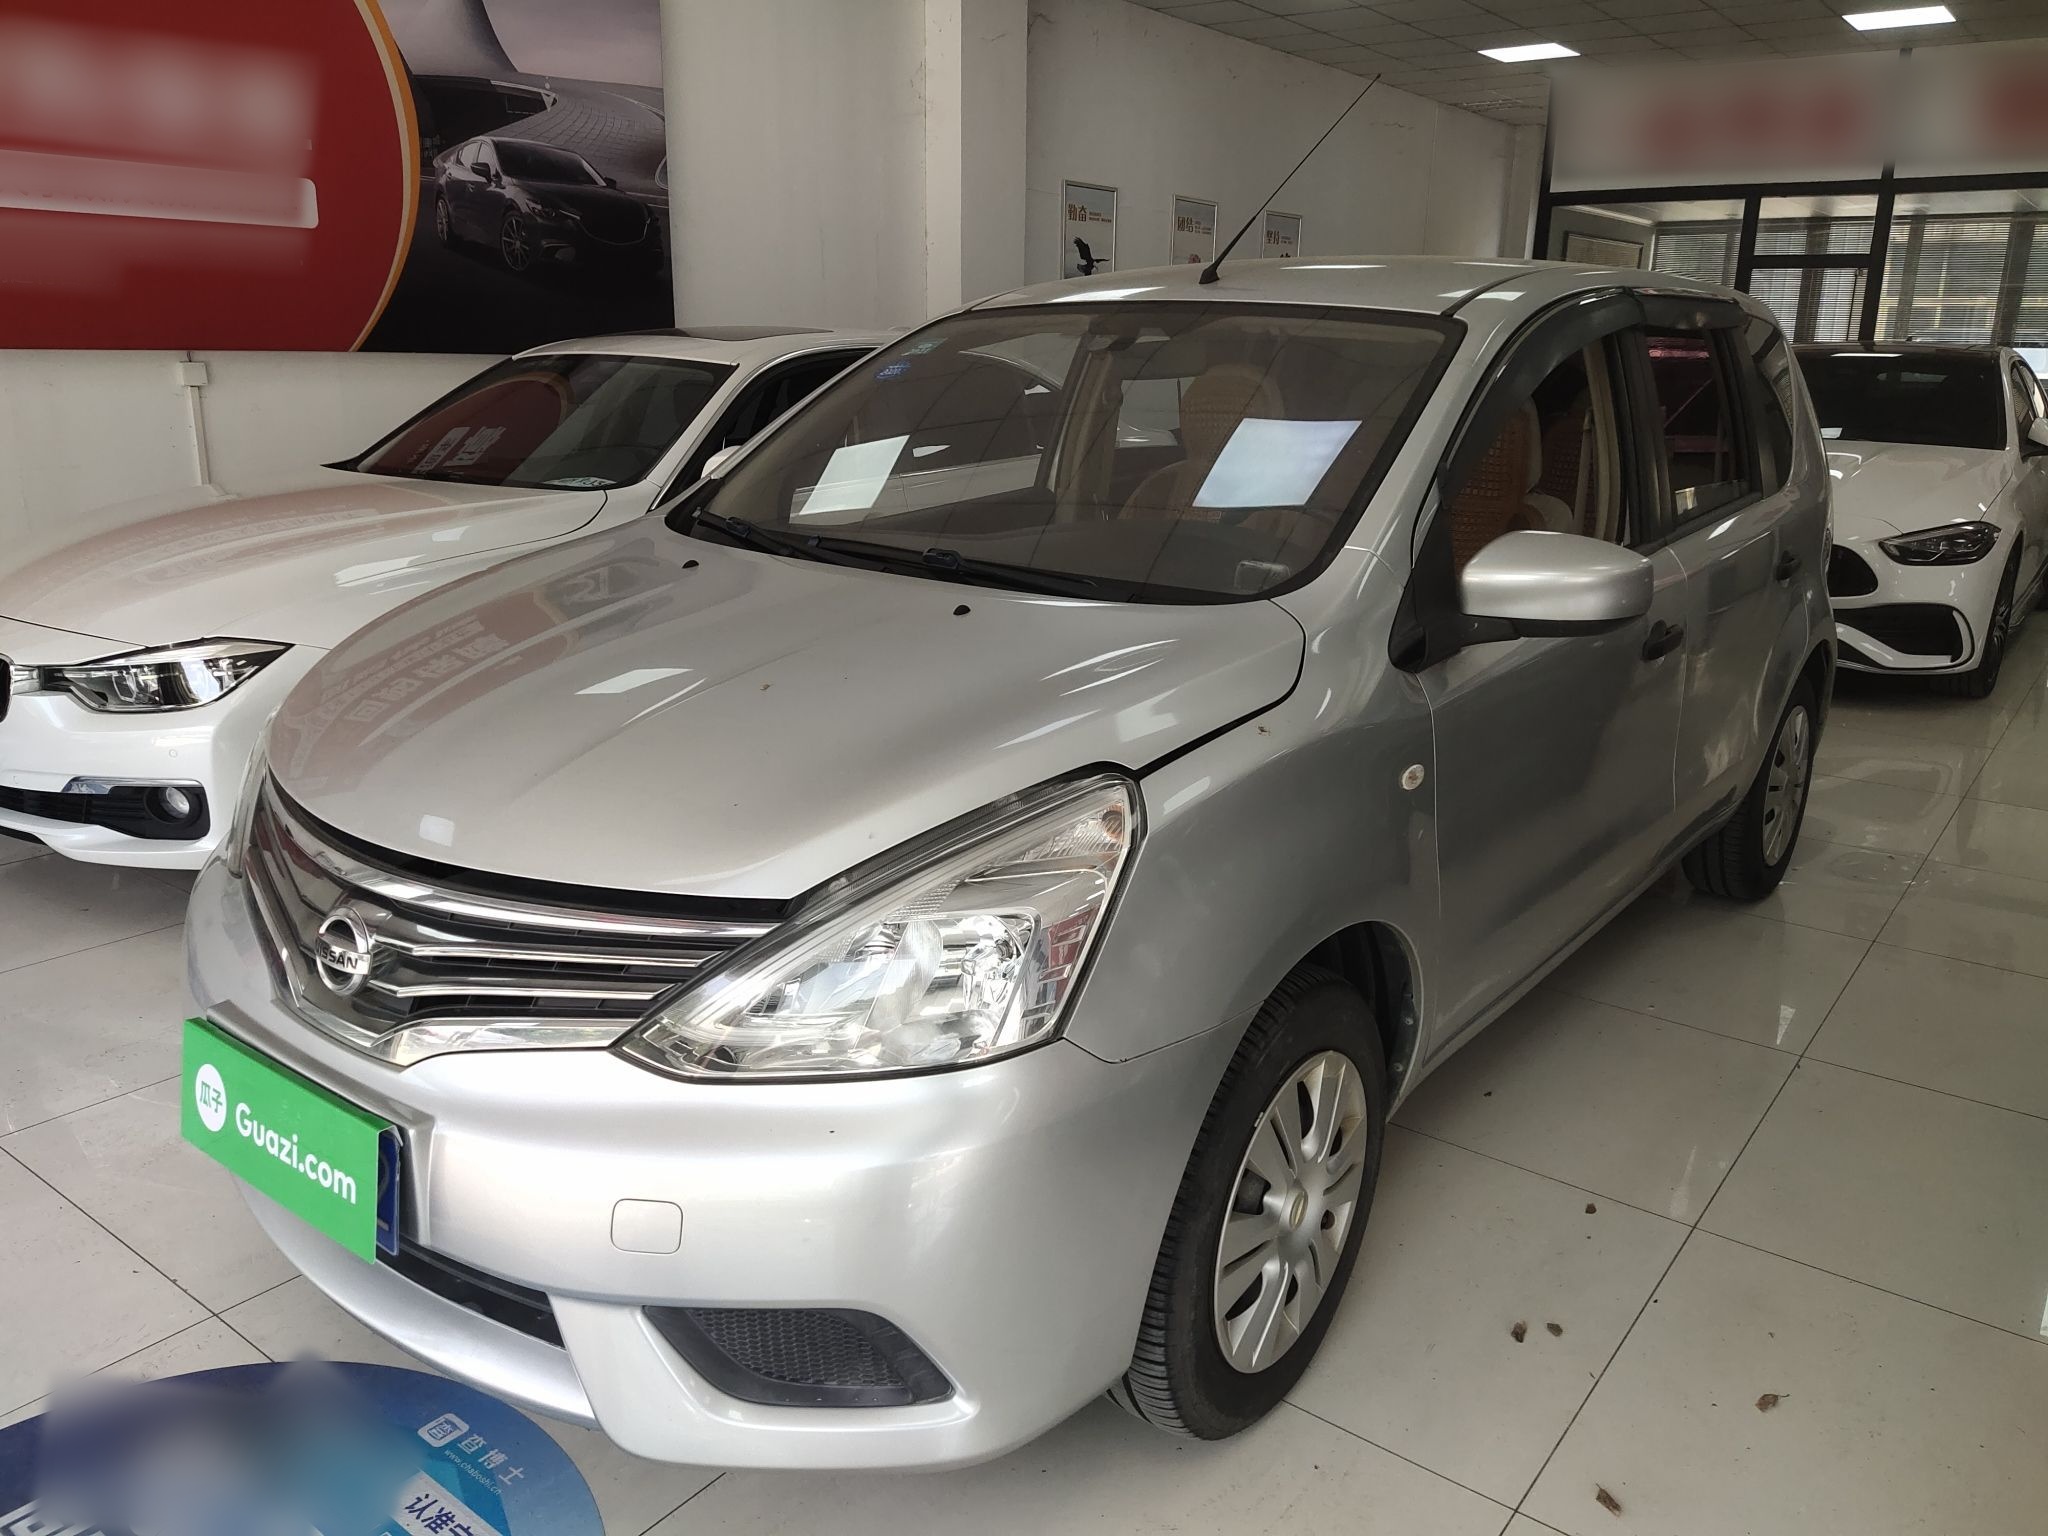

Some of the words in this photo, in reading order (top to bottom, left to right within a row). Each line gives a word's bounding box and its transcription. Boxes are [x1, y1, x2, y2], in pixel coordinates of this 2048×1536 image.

[1068, 203, 1087, 221] 勤奋
[1177, 216, 1194, 233] 团结
[200, 1081, 224, 1114] 瓜子
[235, 1102, 357, 1205] Guazi.com
[444, 1449, 502, 1495] www.chaboshi.cn
[457, 1433, 525, 1486] 查博士
